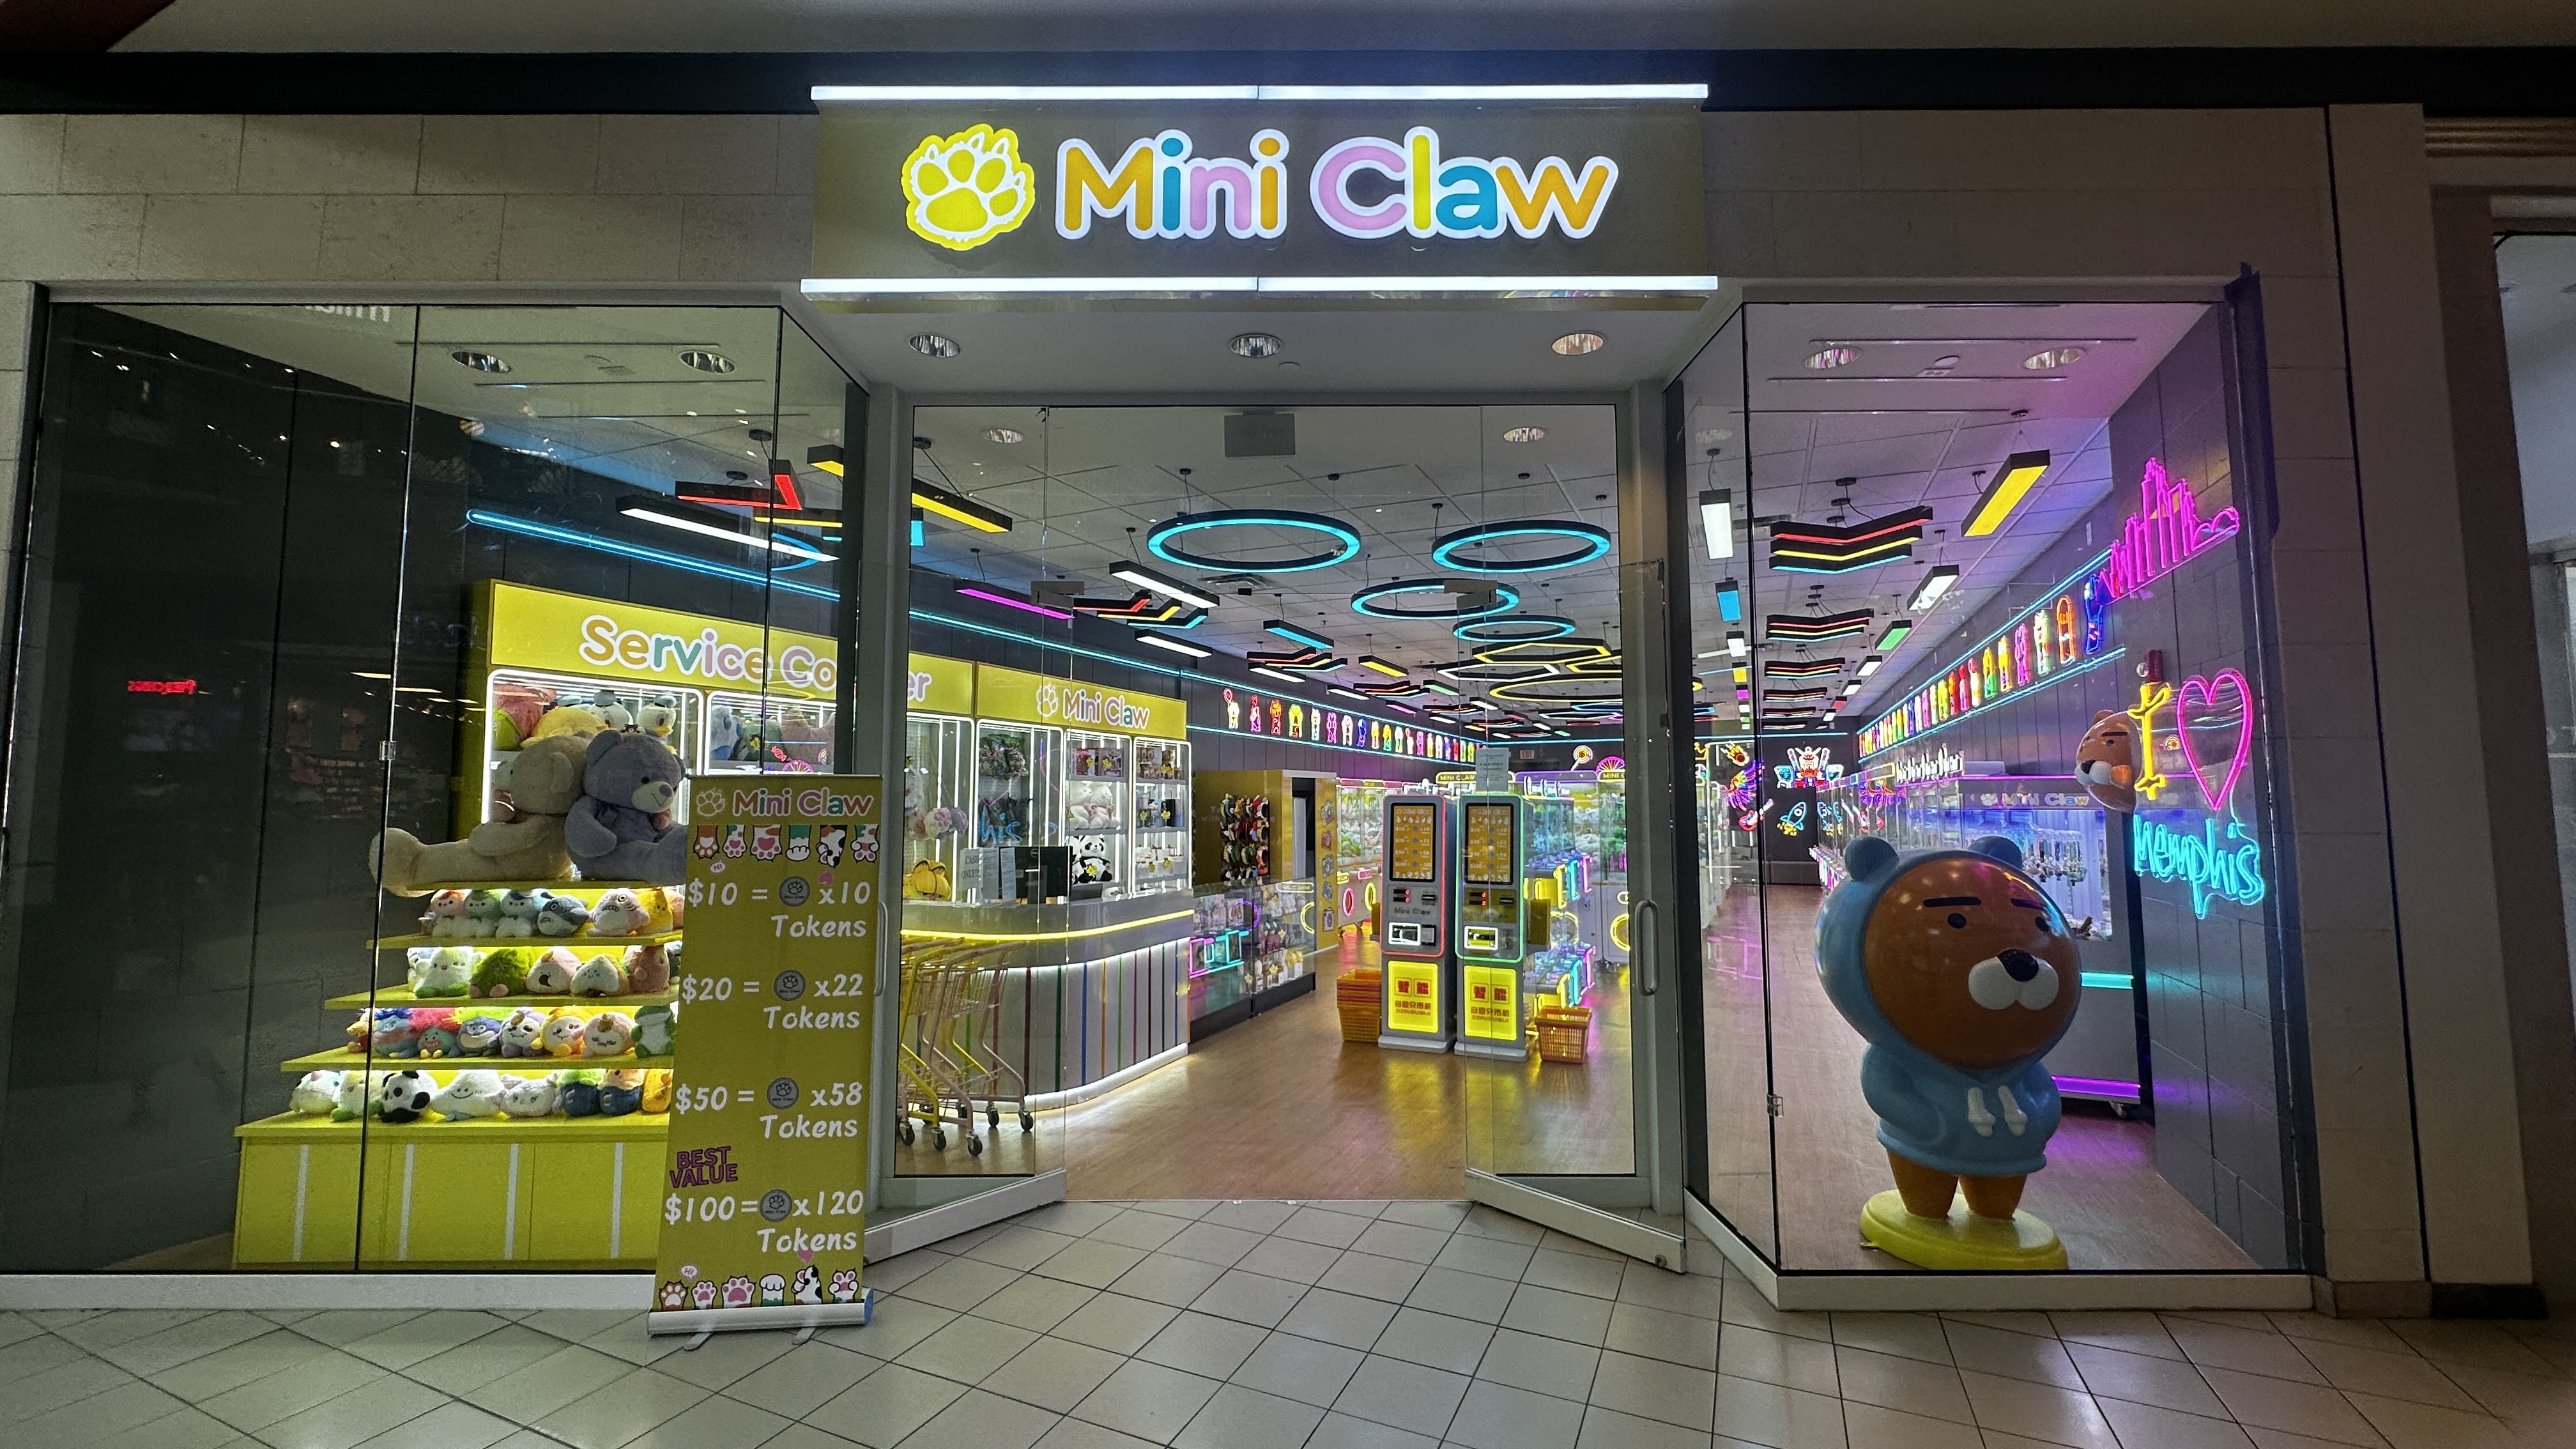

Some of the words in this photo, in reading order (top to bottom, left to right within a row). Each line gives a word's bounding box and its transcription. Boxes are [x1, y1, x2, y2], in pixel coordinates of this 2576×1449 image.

[1055, 128, 1289, 240] Mini
[1309, 126, 1619, 240] Claw
[579, 615, 773, 683] Service
[1062, 688, 1102, 723] Mini
[1104, 694, 1150, 730] Claw
[732, 786, 792, 816] Mini
[797, 786, 874, 816] Claw
[2002, 793, 2039, 806] Mini
[2044, 793, 2089, 806] Claw
[714, 863, 723, 871] HI
[2133, 814, 2263, 919] Memphis
[688, 878, 738, 907] $10
[818, 881, 871, 905] x10
[771, 914, 866, 939] Tokens
[682, 973, 732, 1004] $20
[814, 973, 863, 997] x22
[763, 1006, 859, 1030] Tokens
[675, 1084, 728, 1115] $50
[810, 1082, 862, 1107] x58
[760, 1114, 857, 1138] Tokens
[677, 1146, 732, 1170] BEST
[670, 1163, 738, 1188] VALUE
[664, 1193, 735, 1225] $100
[793, 1190, 864, 1216] x120
[756, 1227, 857, 1253] Tokens
[684, 1267, 694, 1275] HI
